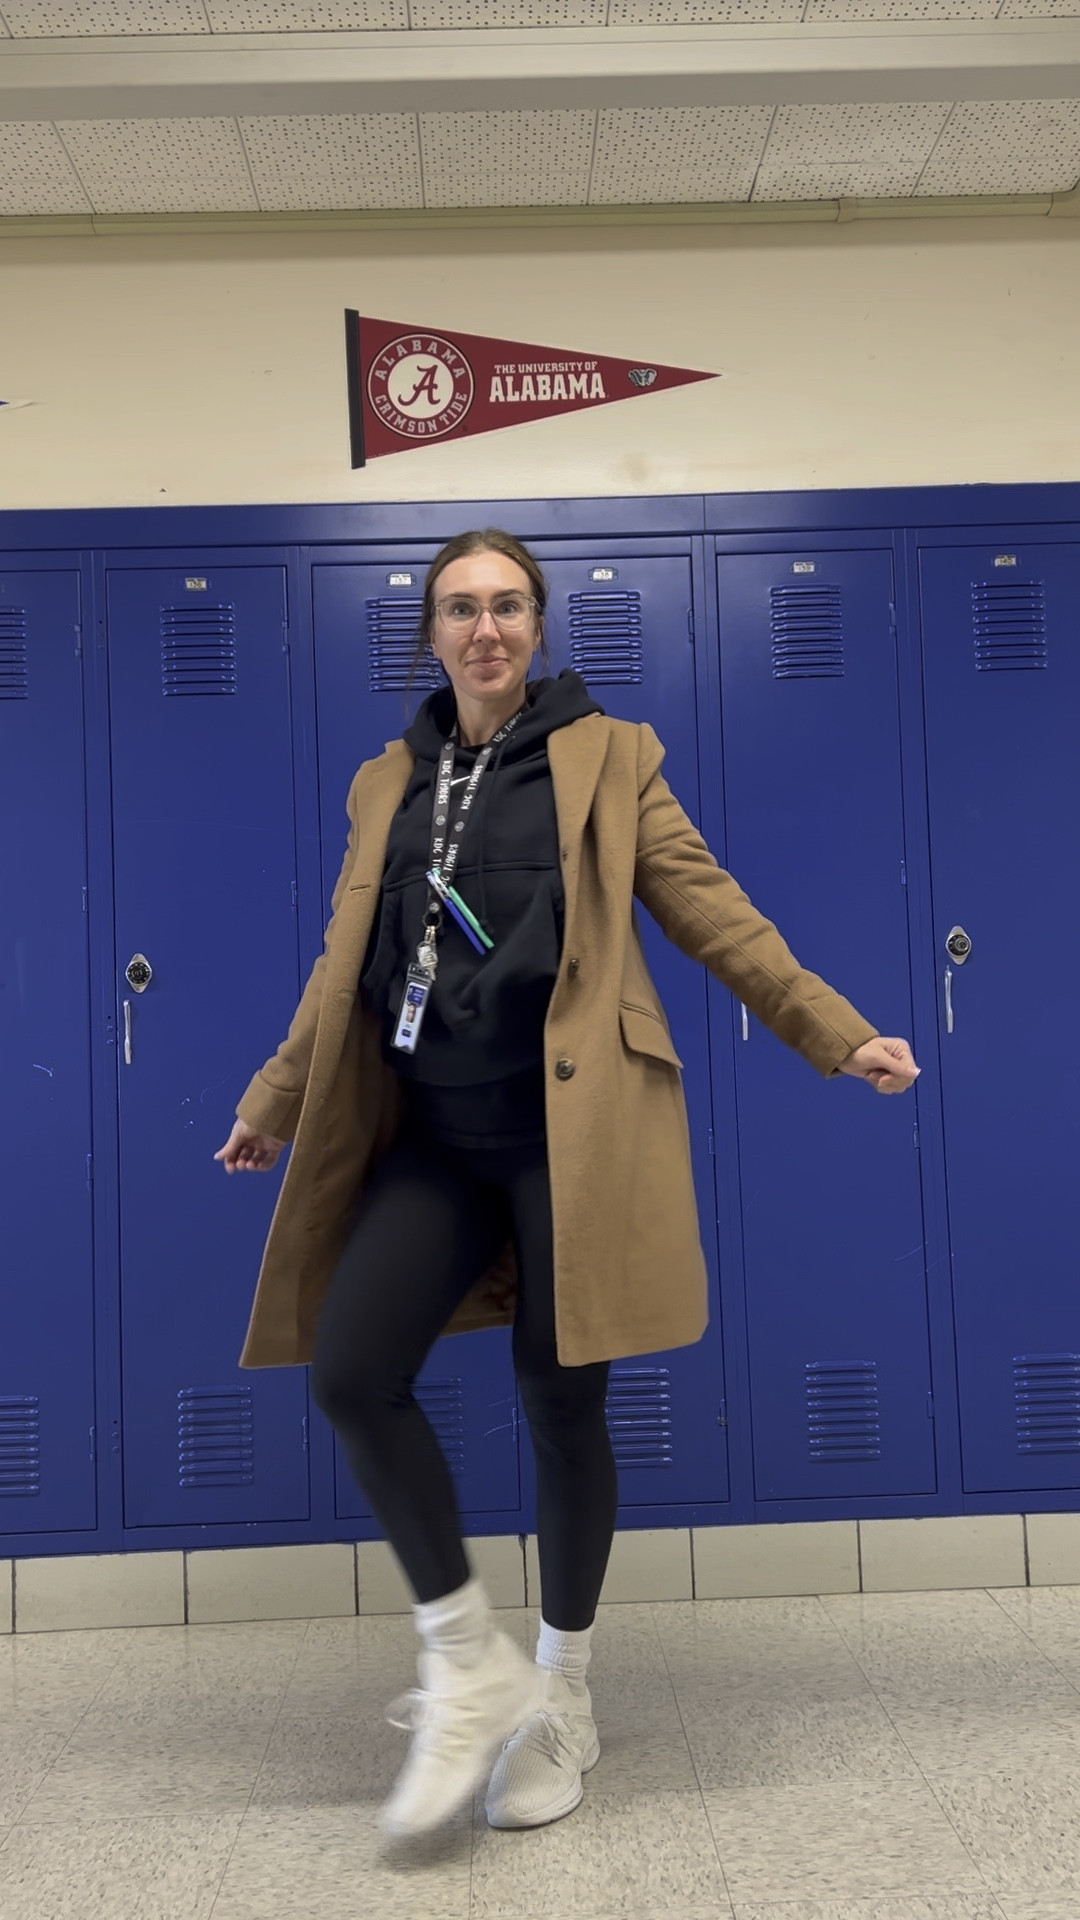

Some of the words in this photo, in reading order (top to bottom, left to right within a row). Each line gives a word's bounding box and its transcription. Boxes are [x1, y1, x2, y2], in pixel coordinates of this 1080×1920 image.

[375, 340, 465, 380] ALABAMA
[494, 364, 516, 374] THE
[518, 362, 583, 373] UNIVERSITY
[584, 361, 598, 371] OF
[398, 365, 441, 406] A
[489, 373, 606, 402] ALABAMA
[375, 394, 438, 433] CRIMSON
[438, 392, 467, 425] TIDE
[433, 837, 443, 854] KDC
